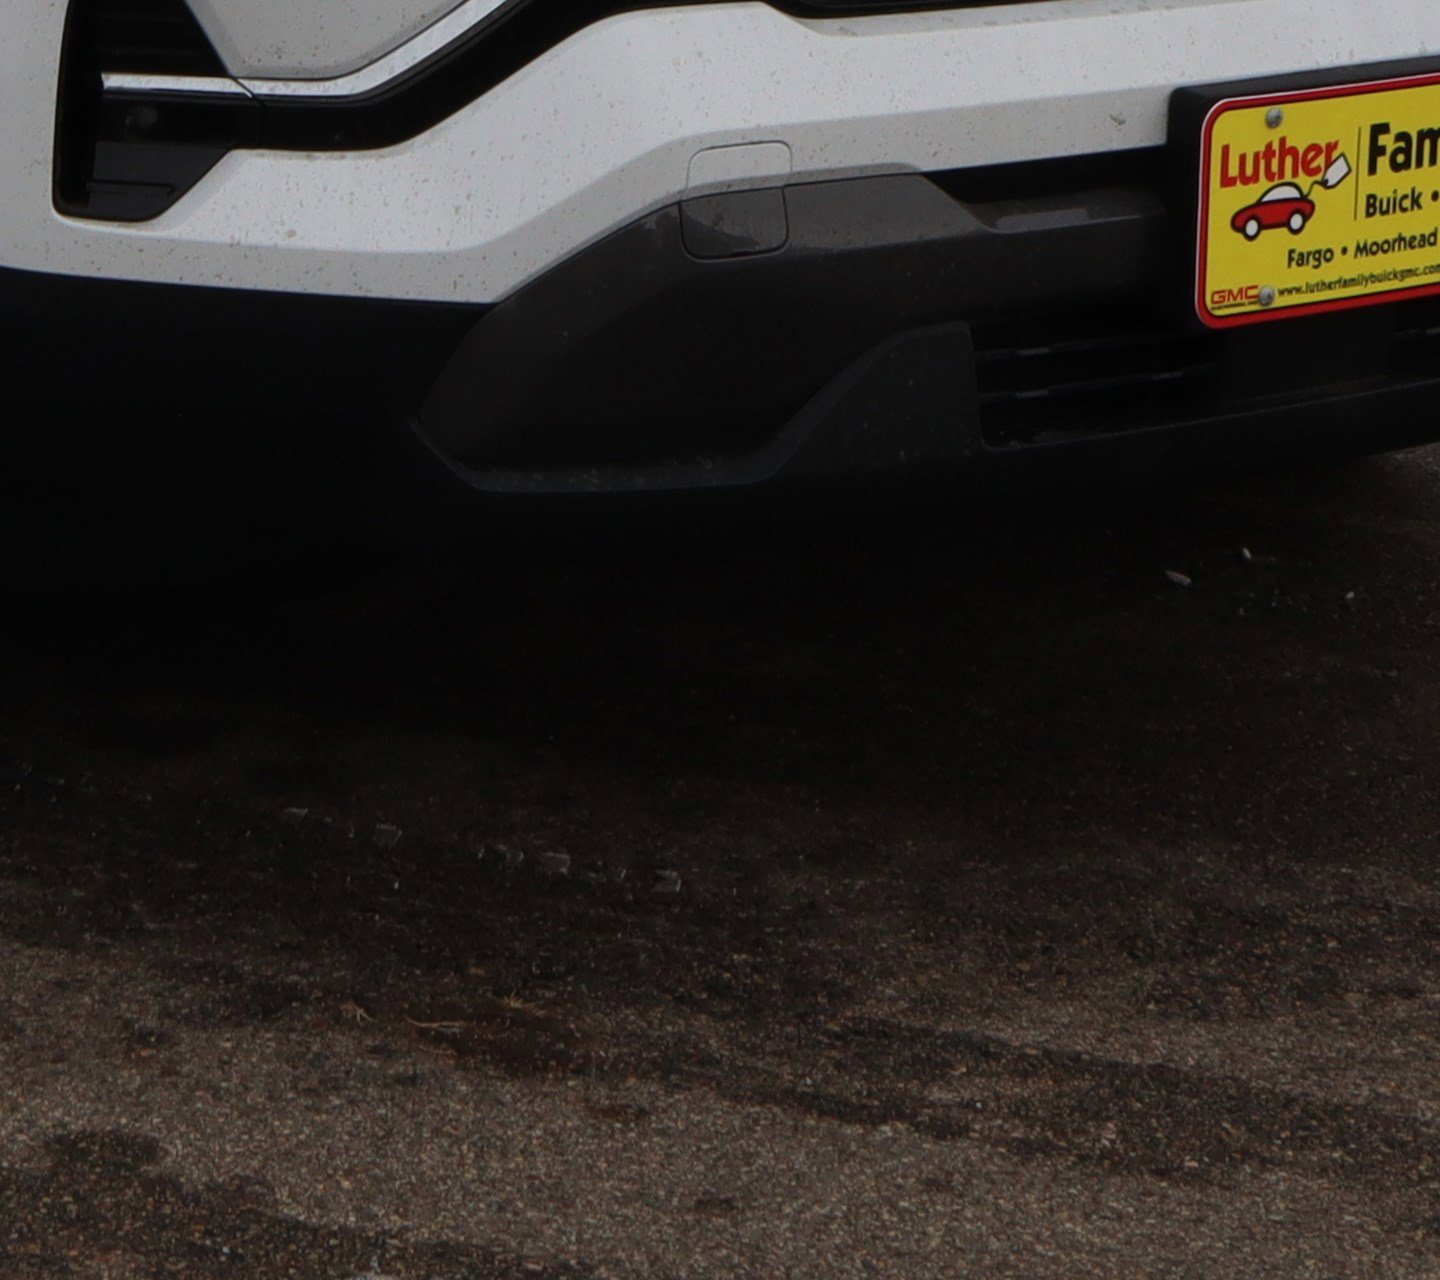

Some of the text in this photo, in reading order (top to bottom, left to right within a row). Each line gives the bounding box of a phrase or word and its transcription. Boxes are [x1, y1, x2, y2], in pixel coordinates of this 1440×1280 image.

[1220, 135, 1340, 189] Luther
[1364, 186, 1423, 219] Buick
[1286, 226, 1439, 270] Fargo Moorhead
[1210, 284, 1260, 306] GMC
